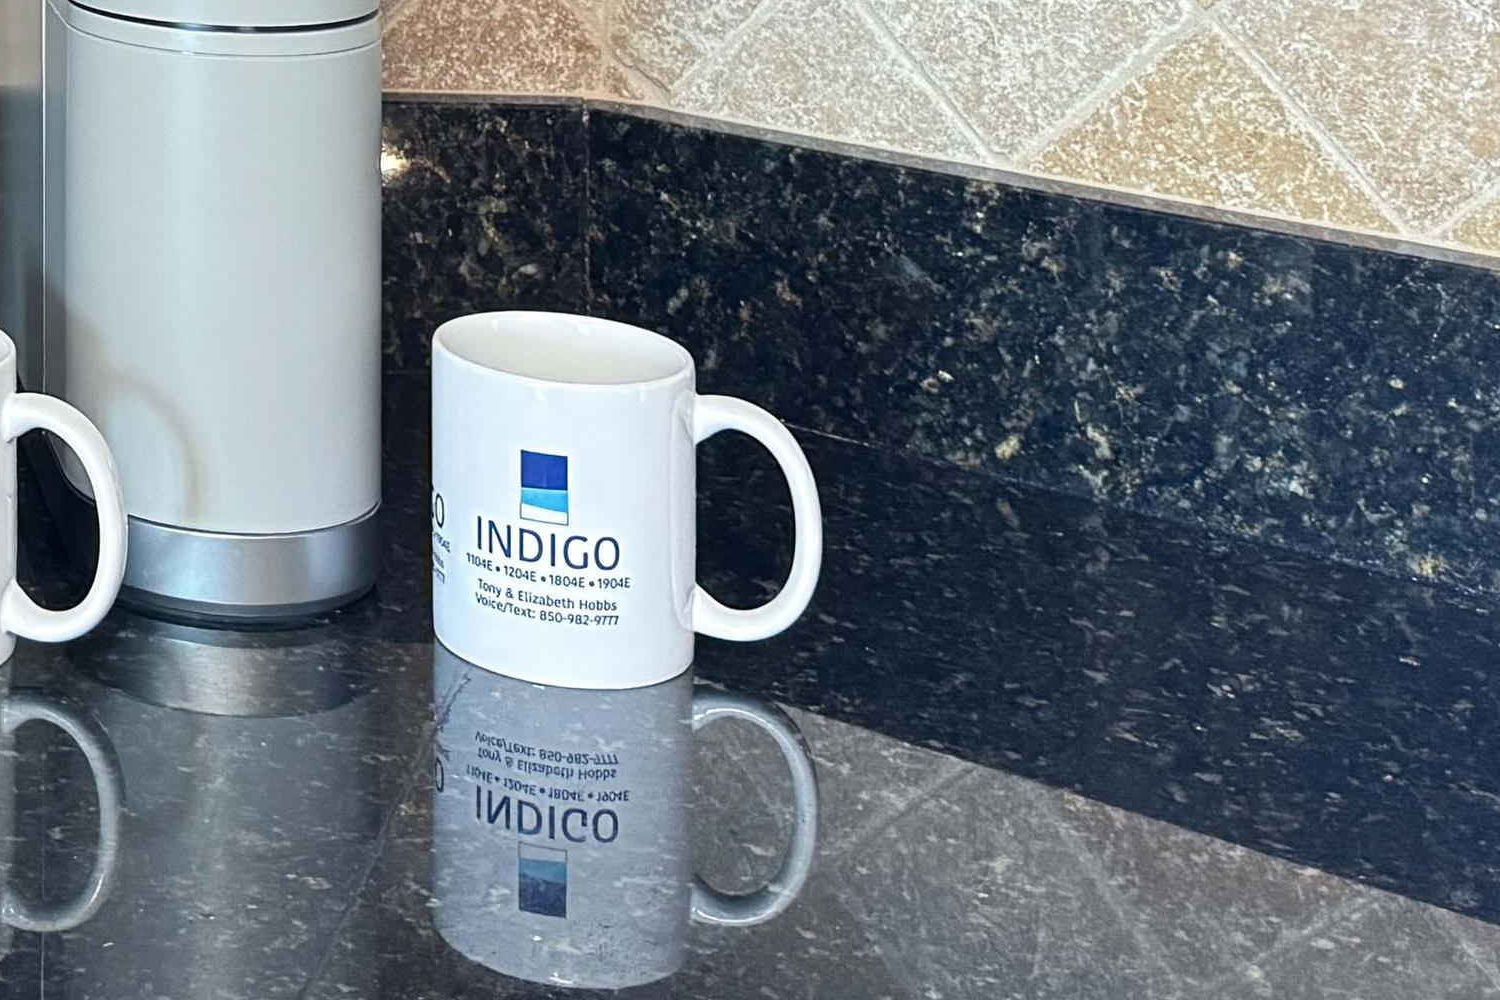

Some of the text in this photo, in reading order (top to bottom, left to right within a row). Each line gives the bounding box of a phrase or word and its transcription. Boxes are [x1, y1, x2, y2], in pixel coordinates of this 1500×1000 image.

[477, 515, 620, 571] INDIGO
[466, 552, 631, 589] 1104E 1204E 1804E 1904E
[475, 592, 619, 626] Voice/Text: 850-982-9777
[477, 578, 618, 611] Tony & Elizabeth Hobbs
